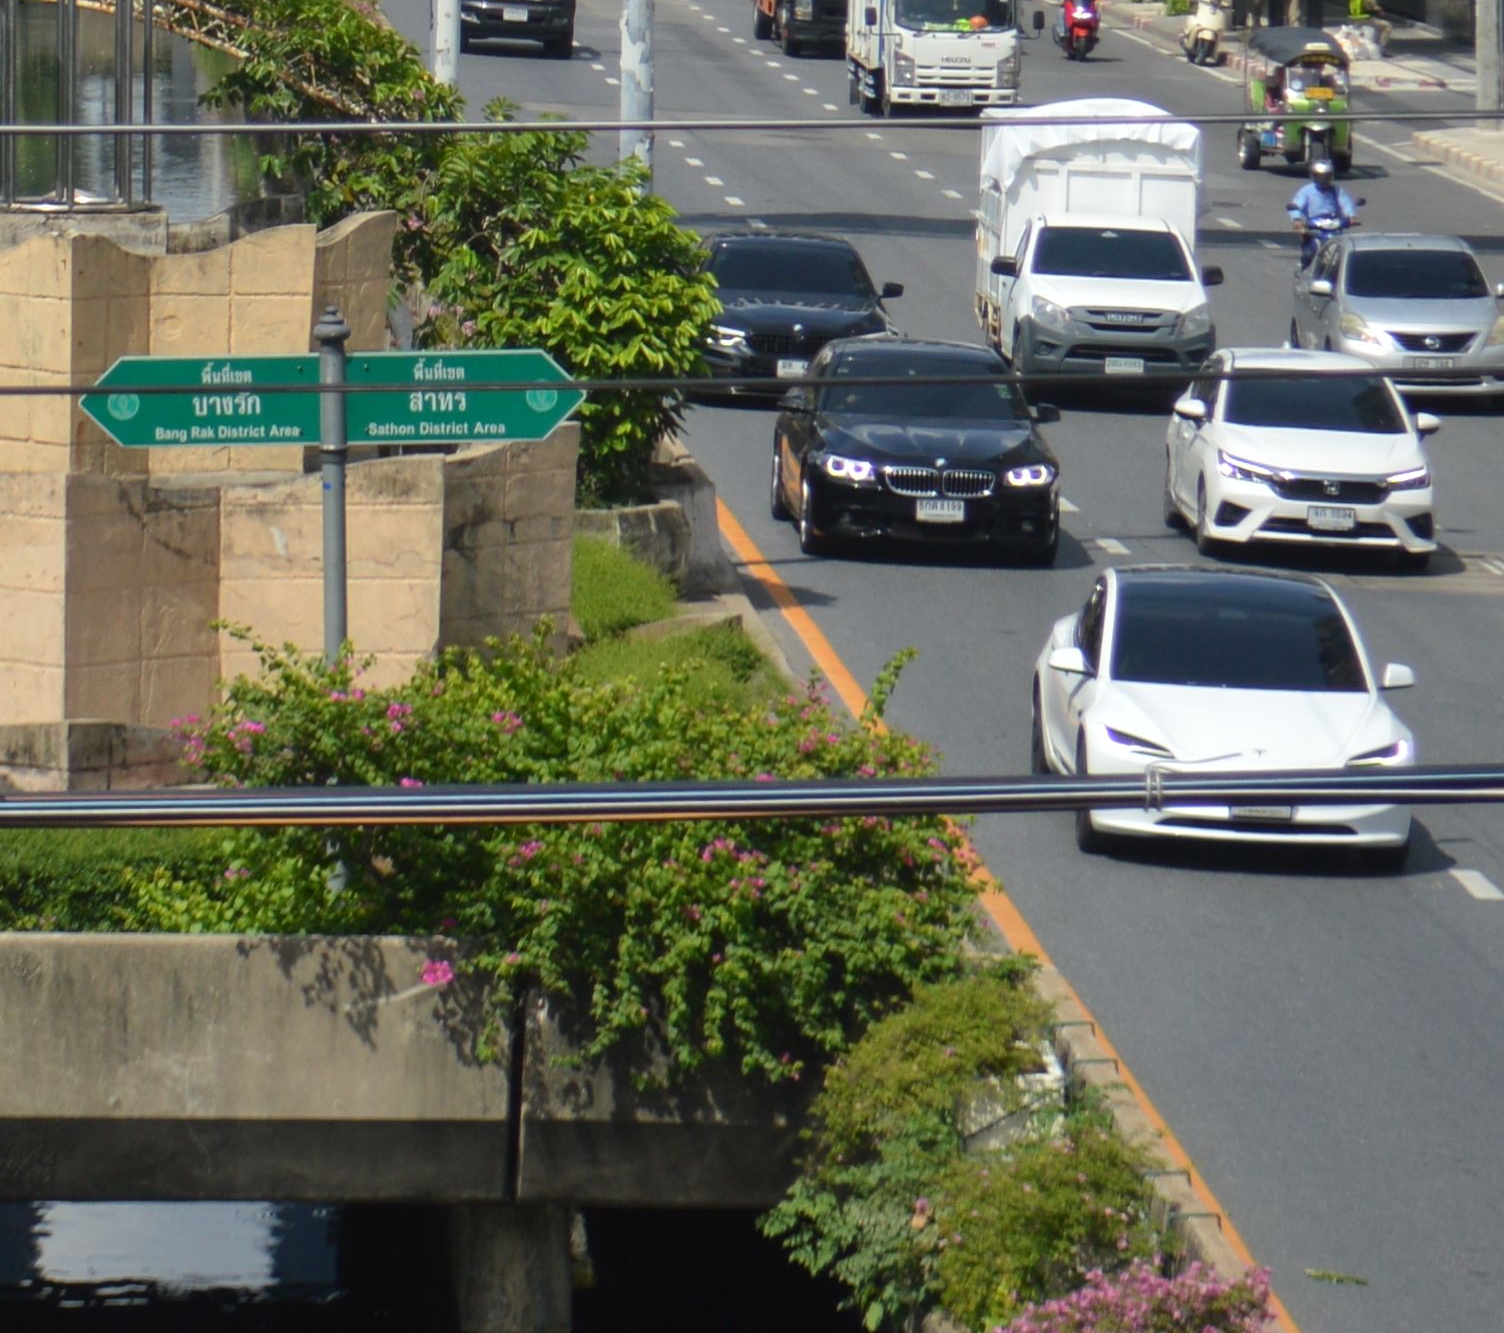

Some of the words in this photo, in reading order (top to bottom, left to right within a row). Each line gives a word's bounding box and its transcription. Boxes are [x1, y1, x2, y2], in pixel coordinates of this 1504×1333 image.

[200, 361, 252, 384] พื้นที่เขต
[413, 358, 466, 381] พื้นที่เขต
[193, 389, 261, 417] บางรัก
[408, 389, 467, 413] สาทร
[155, 427, 188, 442] Bang
[190, 425, 215, 439] Rak
[218, 423, 266, 439] District
[269, 423, 301, 438] Area
[368, 421, 416, 436] Sathon
[419, 421, 470, 436] District
[473, 421, 506, 435] Area
